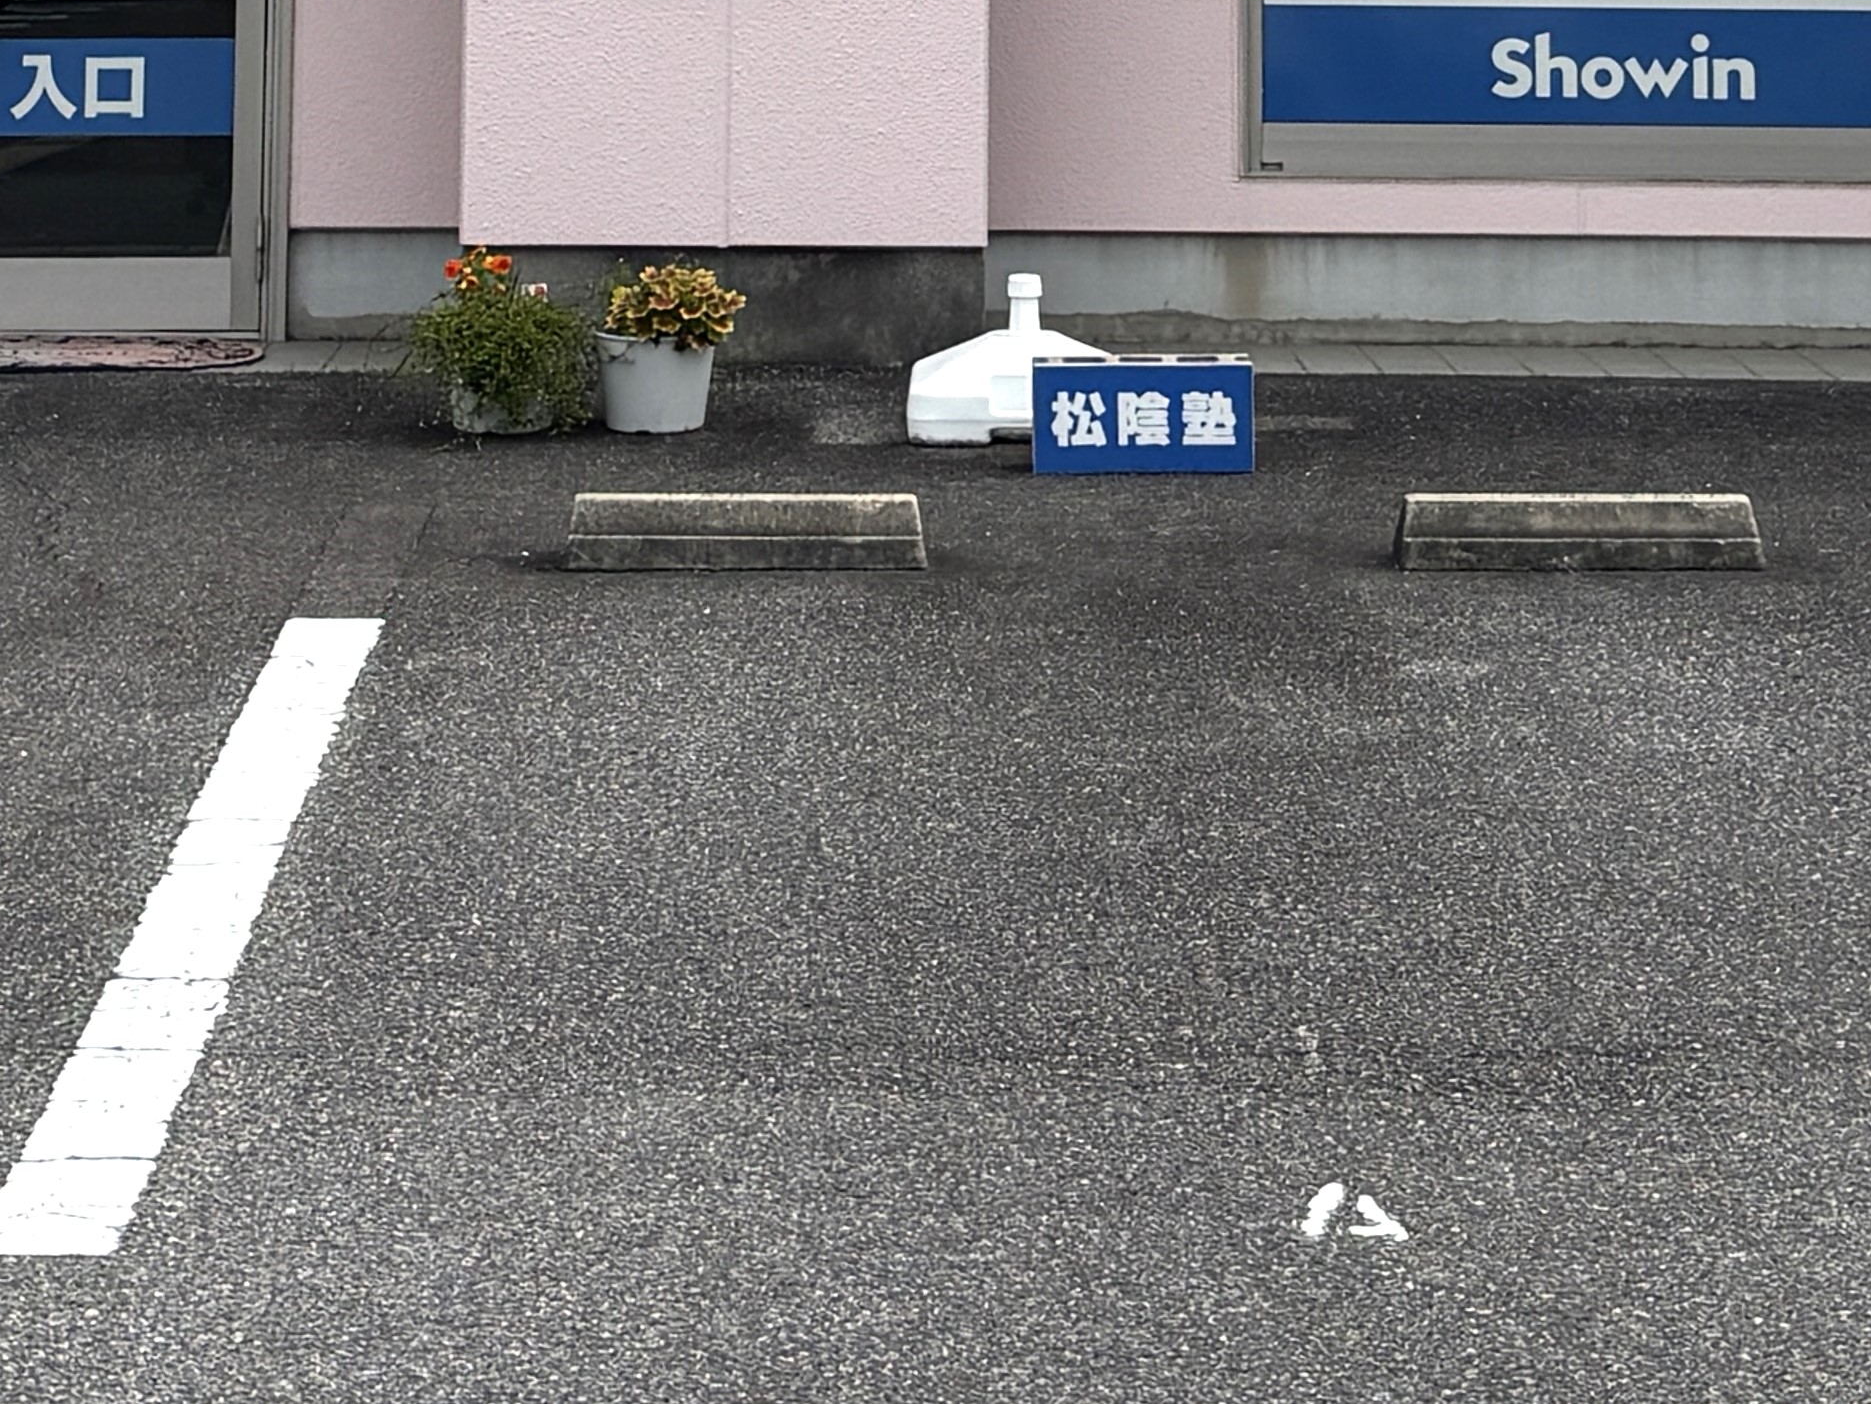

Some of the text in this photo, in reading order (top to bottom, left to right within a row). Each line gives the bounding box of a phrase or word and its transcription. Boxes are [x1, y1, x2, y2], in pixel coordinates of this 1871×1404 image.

[10, 53, 146, 121] 入口
[1491, 31, 1757, 101] Showin
[1050, 390, 1238, 448] 松陰塾
